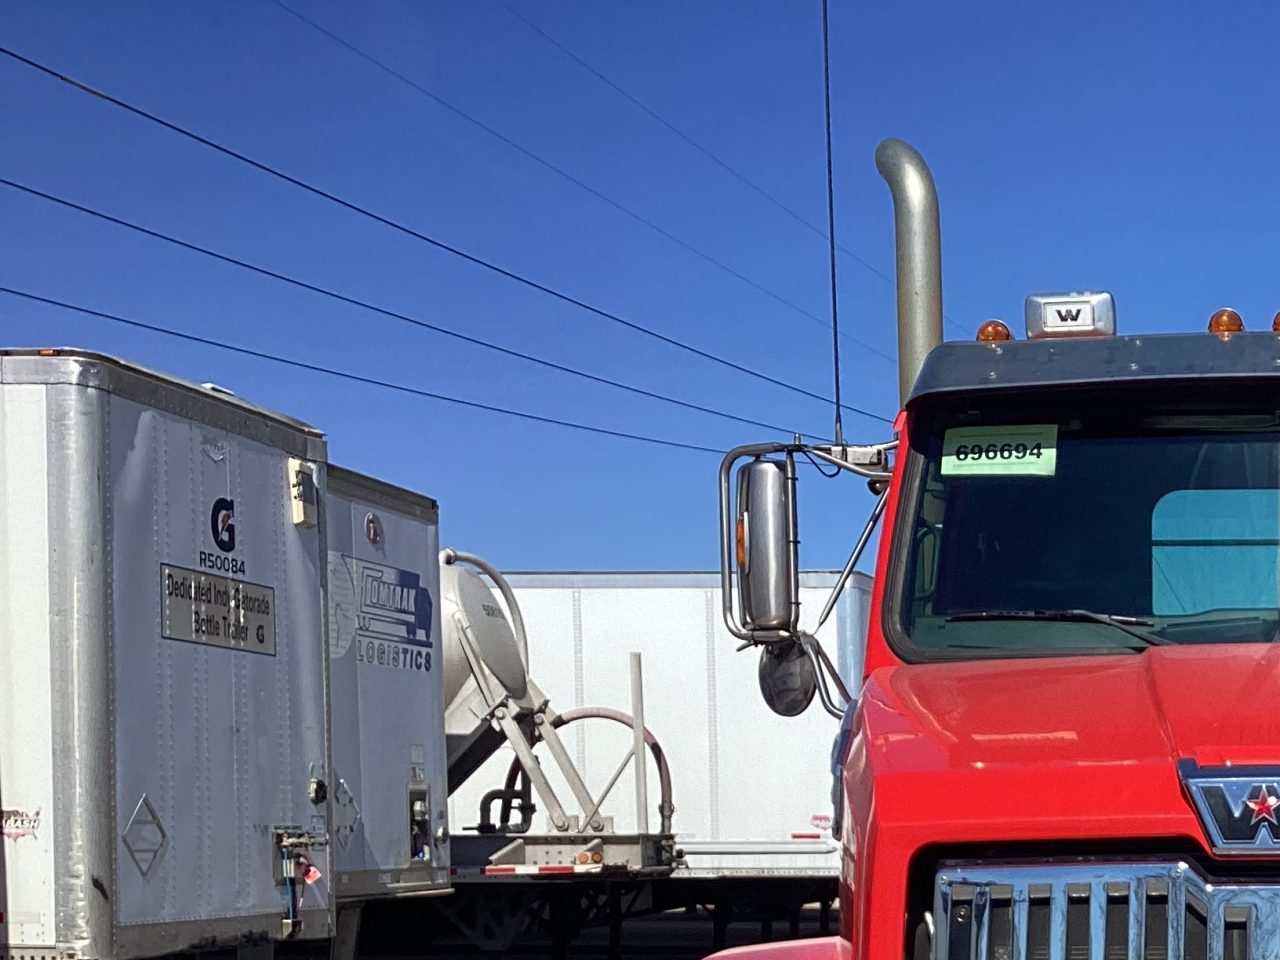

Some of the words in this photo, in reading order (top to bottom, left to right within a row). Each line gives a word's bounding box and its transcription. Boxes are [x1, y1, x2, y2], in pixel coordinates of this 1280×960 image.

[955, 442, 1043, 461] 696694
[211, 497, 236, 553] G
[200, 551, 246, 575] R50084
[167, 574, 212, 605] Dedicated
[214, 583, 231, 613] Indy
[233, 588, 270, 617] Gatorade
[194, 611, 220, 638] Bottle
[221, 616, 249, 642] Trailer
[256, 624, 265, 644] G
[357, 639, 433, 673] LOGISTICS
